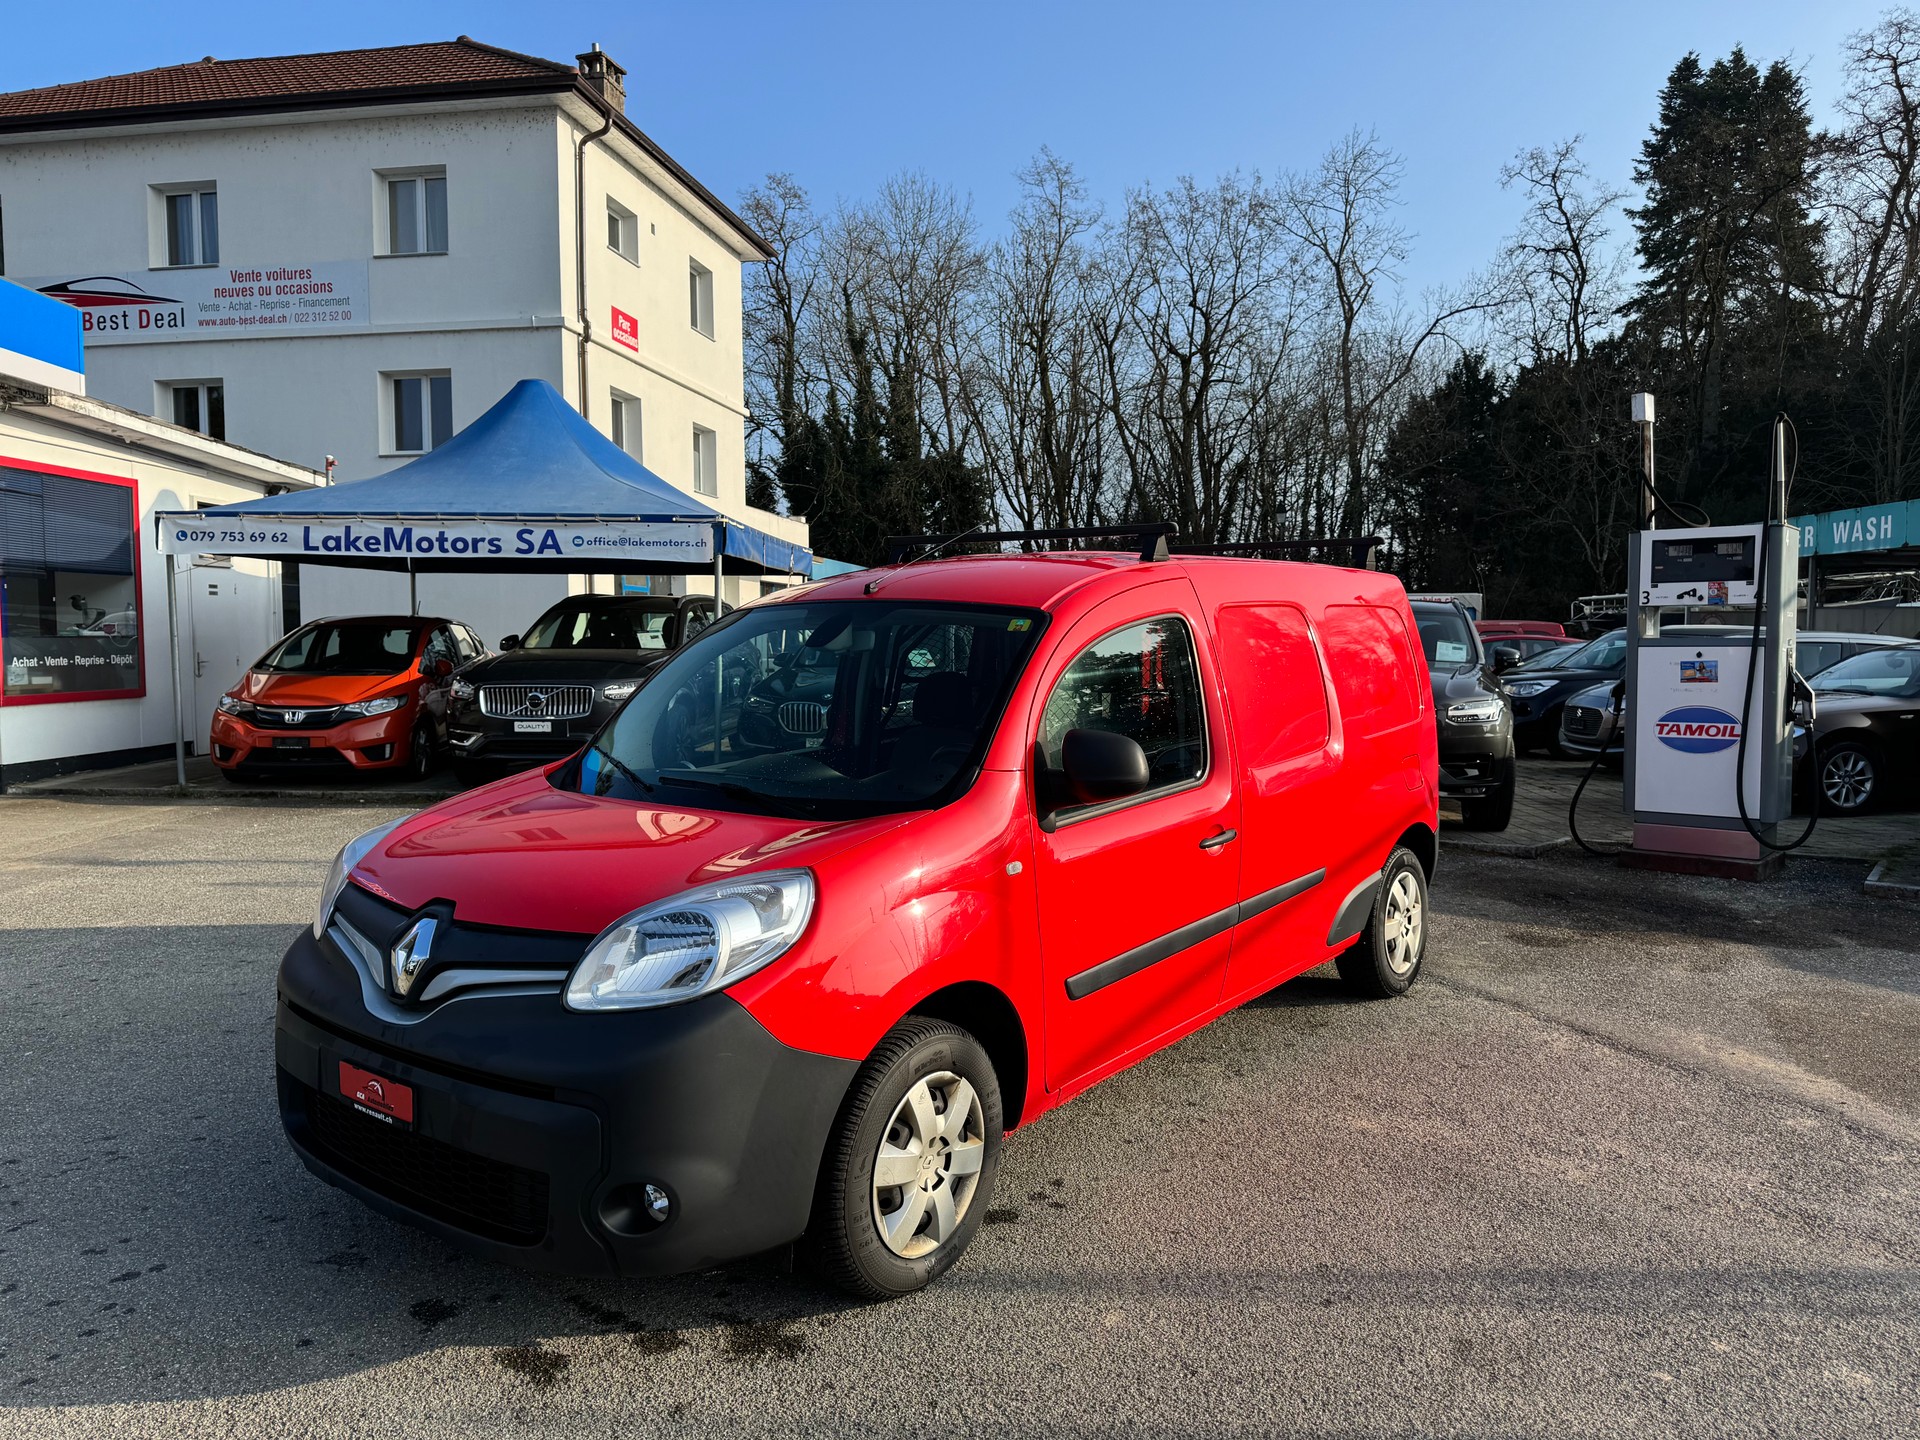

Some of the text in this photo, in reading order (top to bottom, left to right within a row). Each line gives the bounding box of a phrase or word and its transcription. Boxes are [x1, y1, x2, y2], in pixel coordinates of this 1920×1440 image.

[230, 268, 312, 283] Vente voitures
[214, 281, 333, 298] neuves ou occasions
[198, 302, 220, 313] Vente
[228, 300, 252, 312] Achat
[259, 299, 290, 312] Reprise
[298, 296, 351, 308] Financement
[82, 307, 186, 332] Best Deal
[198, 313, 287, 327] www.auto-best-deal.ch
[294, 312, 310, 323] 022
[311, 311, 327, 322] 312
[328, 311, 339, 321] 52
[341, 310, 352, 321] 00
[190, 530, 288, 543] 079 753 69 62
[303, 525, 563, 555] LakeMotors SA
[1798, 515, 1892, 548] R WASH
[586, 535, 708, 549] office@lakemotors.ch
[1641, 590, 1650, 605] 3
[12, 656, 38, 667] Achat
[44, 656, 68, 666] Vente
[75, 655, 104, 667] Reprise
[111, 654, 132, 666] Dépôt
[1655, 723, 1741, 738] TAMOIL
[354, 1103, 392, 1124] www.renault.ch
